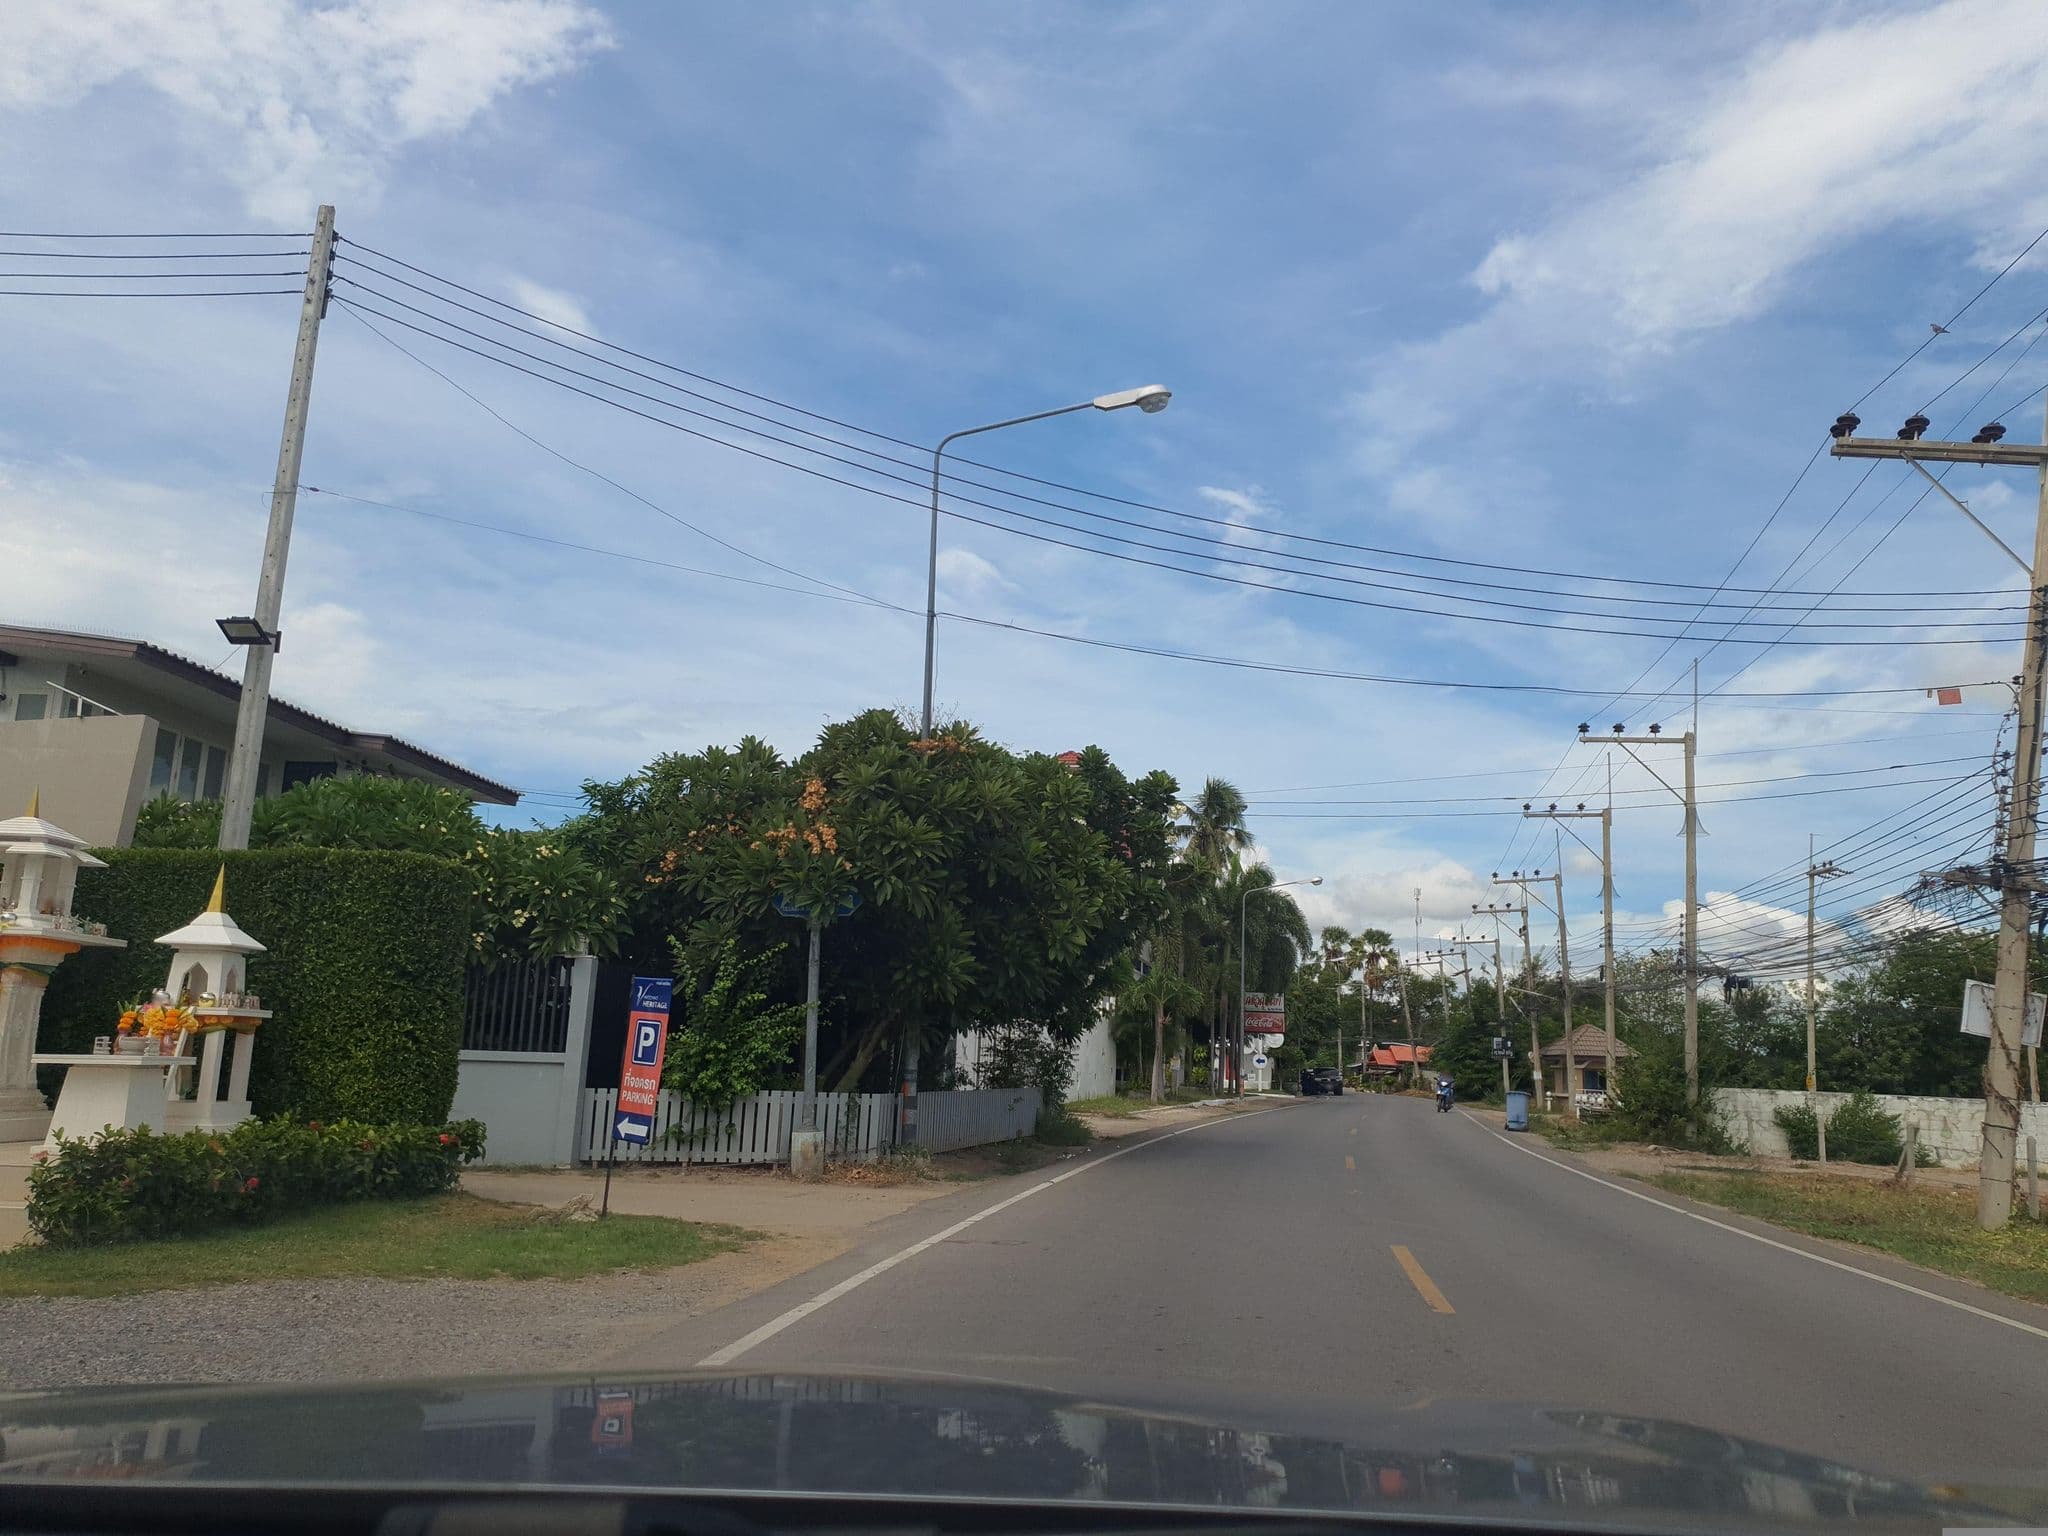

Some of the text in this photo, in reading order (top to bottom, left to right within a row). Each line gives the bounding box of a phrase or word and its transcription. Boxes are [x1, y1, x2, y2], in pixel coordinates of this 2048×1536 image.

[642, 1000, 668, 1009] HERITAGE
[637, 1026, 655, 1058] P
[621, 1090, 654, 1105] PARKING
